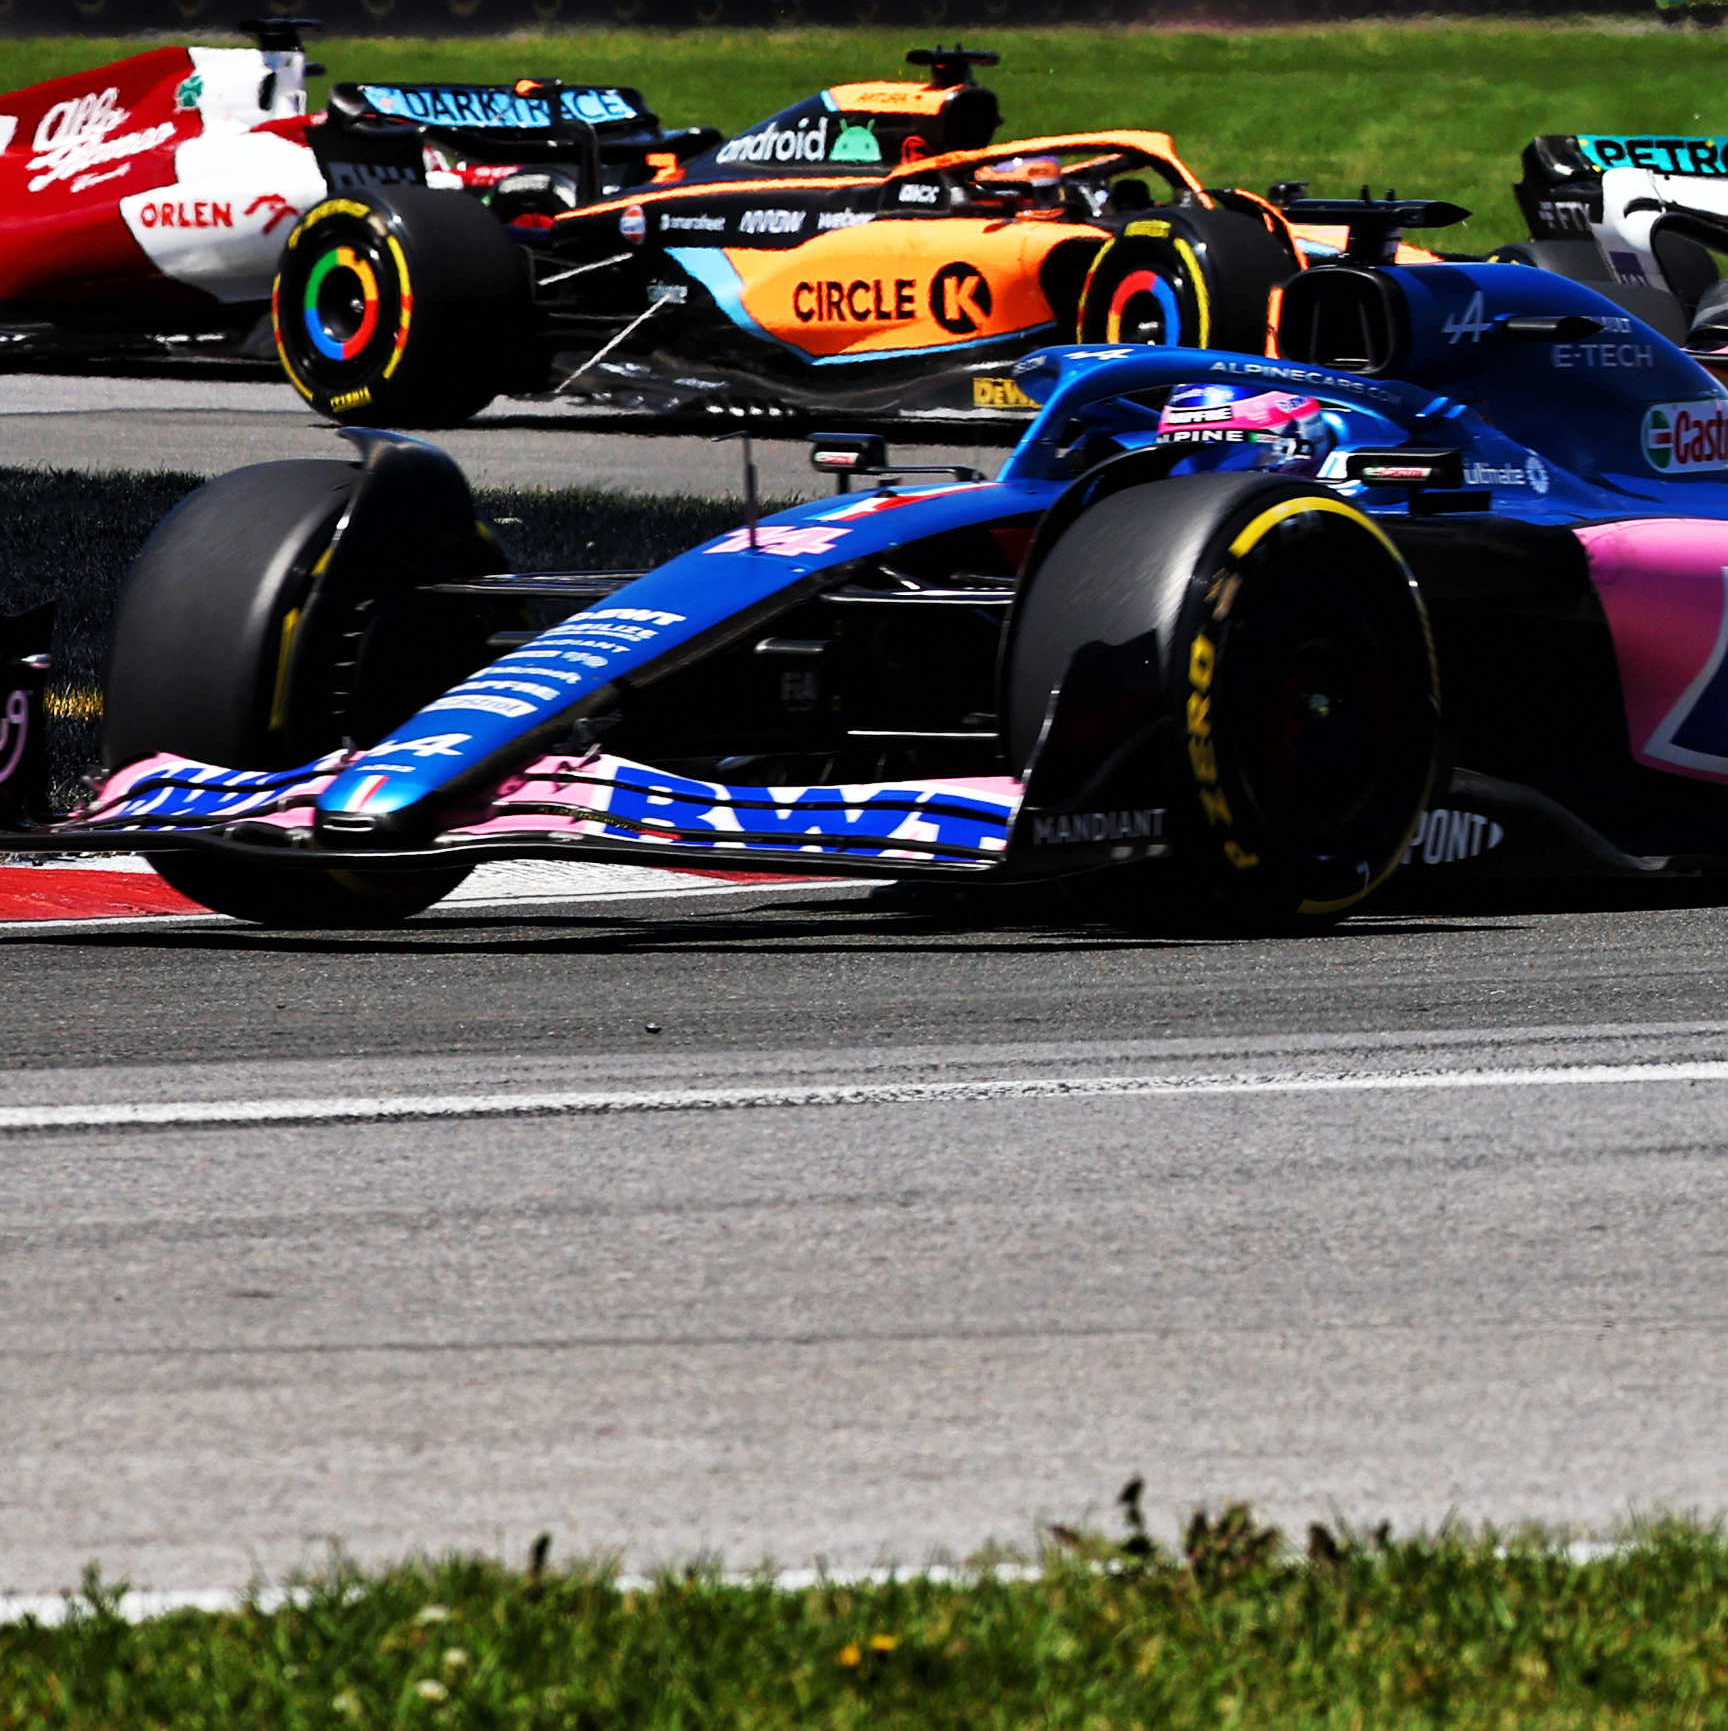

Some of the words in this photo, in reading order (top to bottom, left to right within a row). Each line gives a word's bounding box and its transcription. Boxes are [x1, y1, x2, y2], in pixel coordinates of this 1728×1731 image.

[716, 116, 829, 165] android
[140, 201, 235, 229] ORLEN
[793, 278, 918, 322] CIRCLE
[942, 274, 990, 321] K
[1553, 343, 1654, 369] E-TECH
[703, 525, 854, 558] 14
[1186, 633, 1234, 827] ZERO
[604, 765, 1010, 862] BWT
[1031, 807, 1168, 845] MANDIANT
[1401, 807, 1488, 866] PONT
